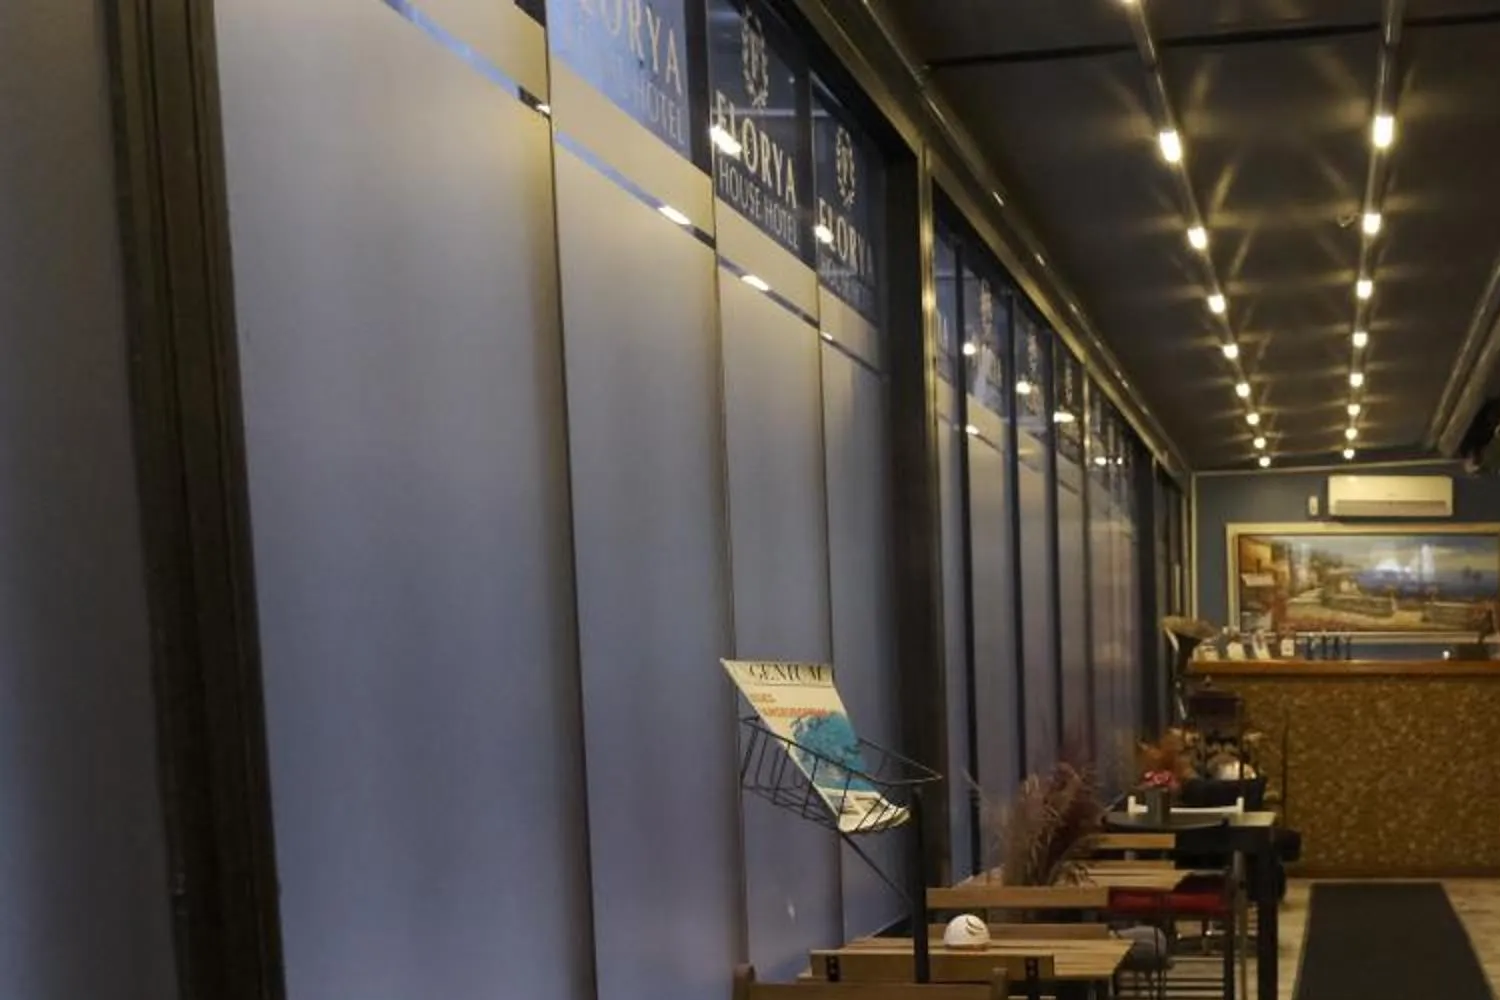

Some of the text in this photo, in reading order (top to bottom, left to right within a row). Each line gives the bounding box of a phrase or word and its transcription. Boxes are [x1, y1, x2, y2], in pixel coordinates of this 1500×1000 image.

[715, 89, 798, 209] FLORYA
[718, 157, 800, 250] HOUSE HOTEL
